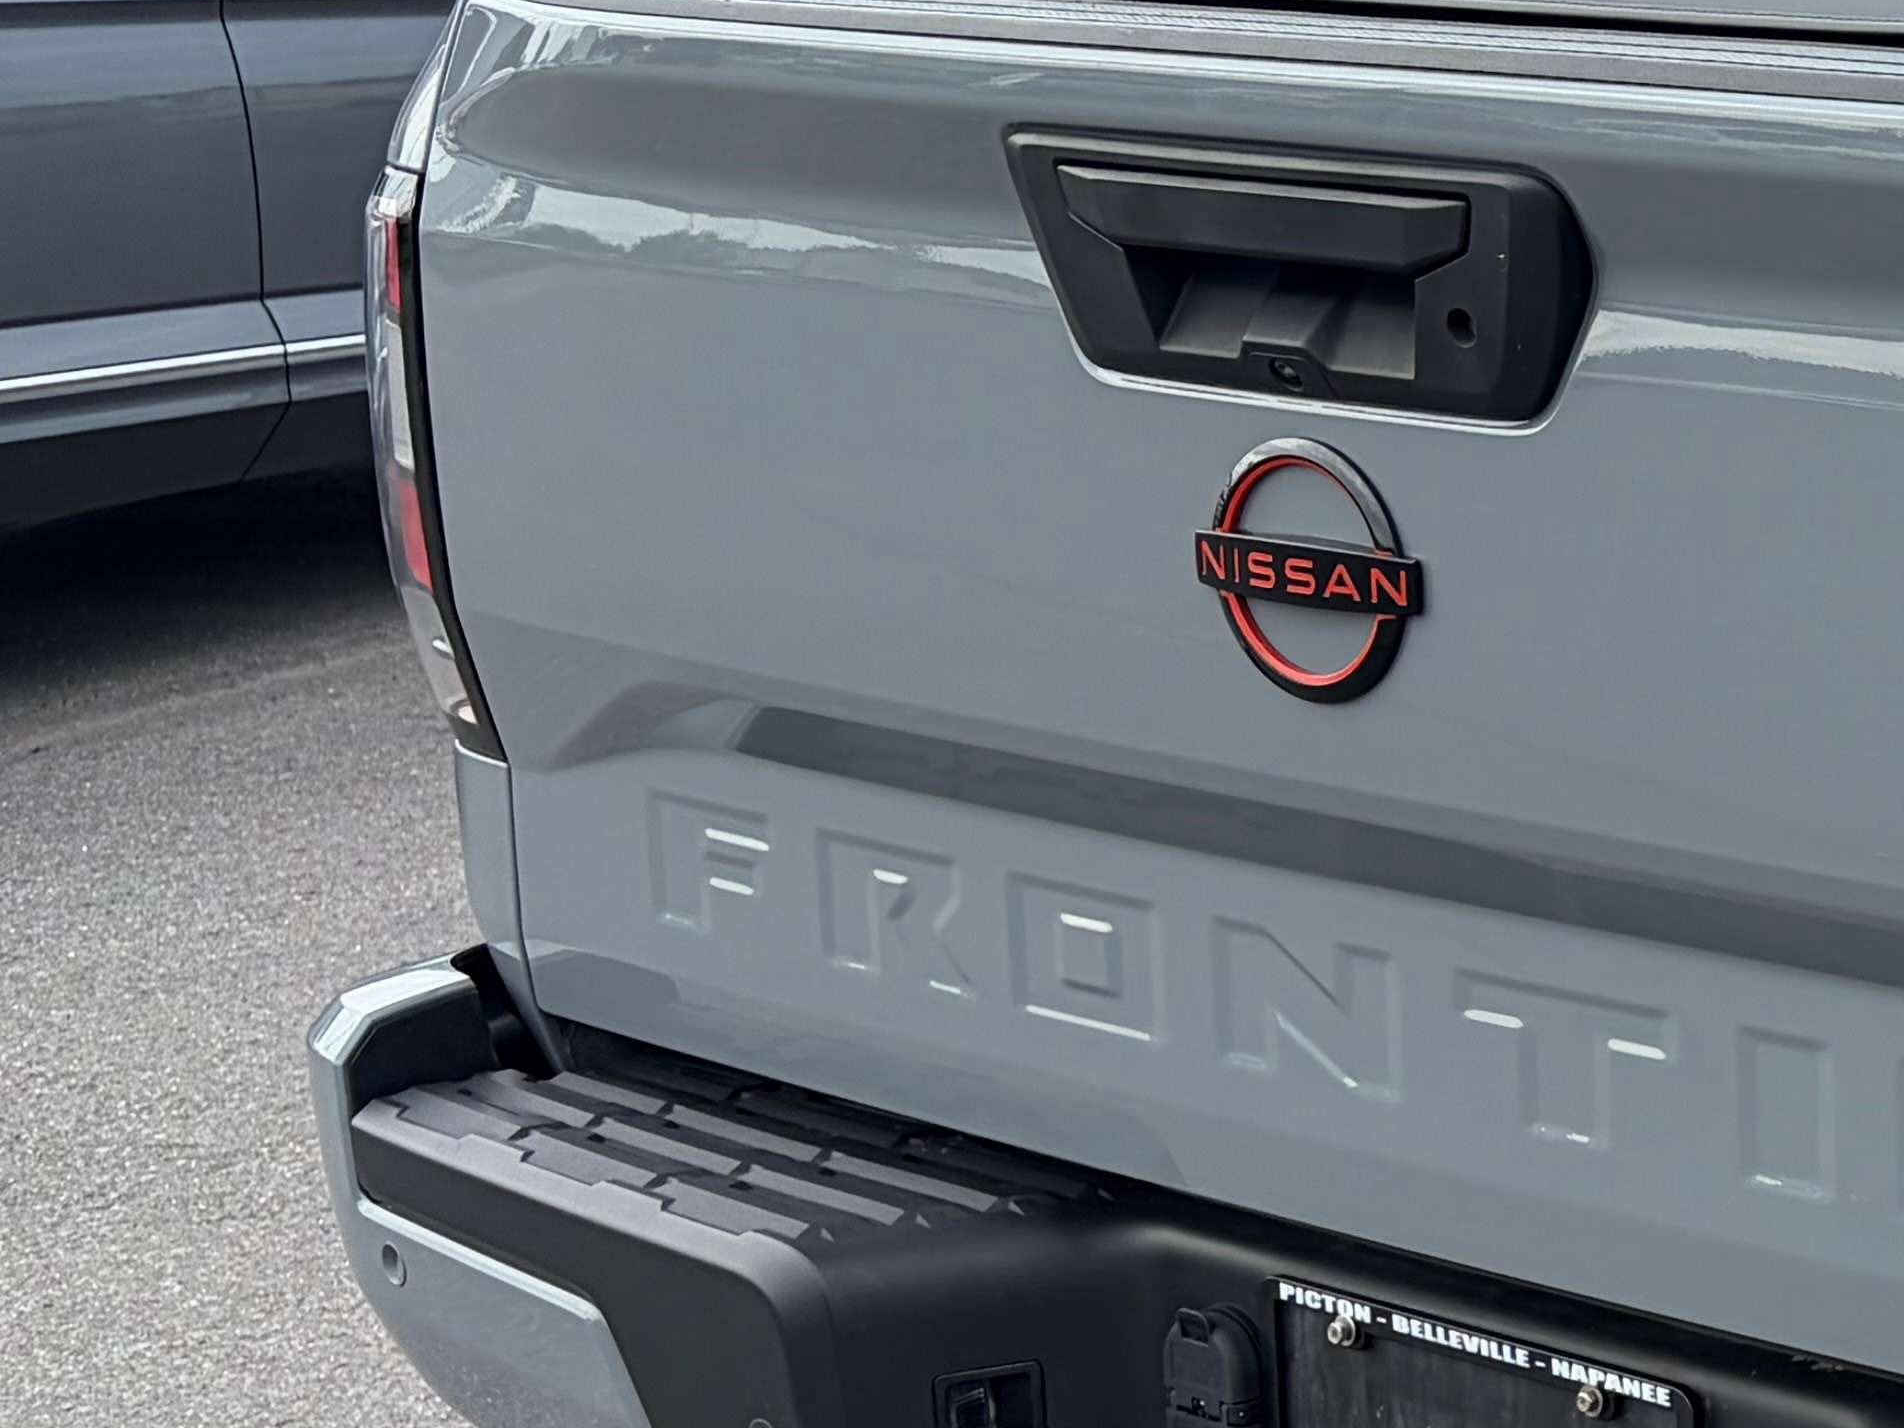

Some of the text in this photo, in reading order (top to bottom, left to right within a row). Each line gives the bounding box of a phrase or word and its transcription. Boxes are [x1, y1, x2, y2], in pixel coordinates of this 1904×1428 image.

[1200, 539, 1408, 607] NISSAN
[1279, 1282, 1371, 1324] PICTON
[1391, 1314, 1531, 1369] BELLEVILLE
[1551, 1358, 1672, 1408] NAPANEE
